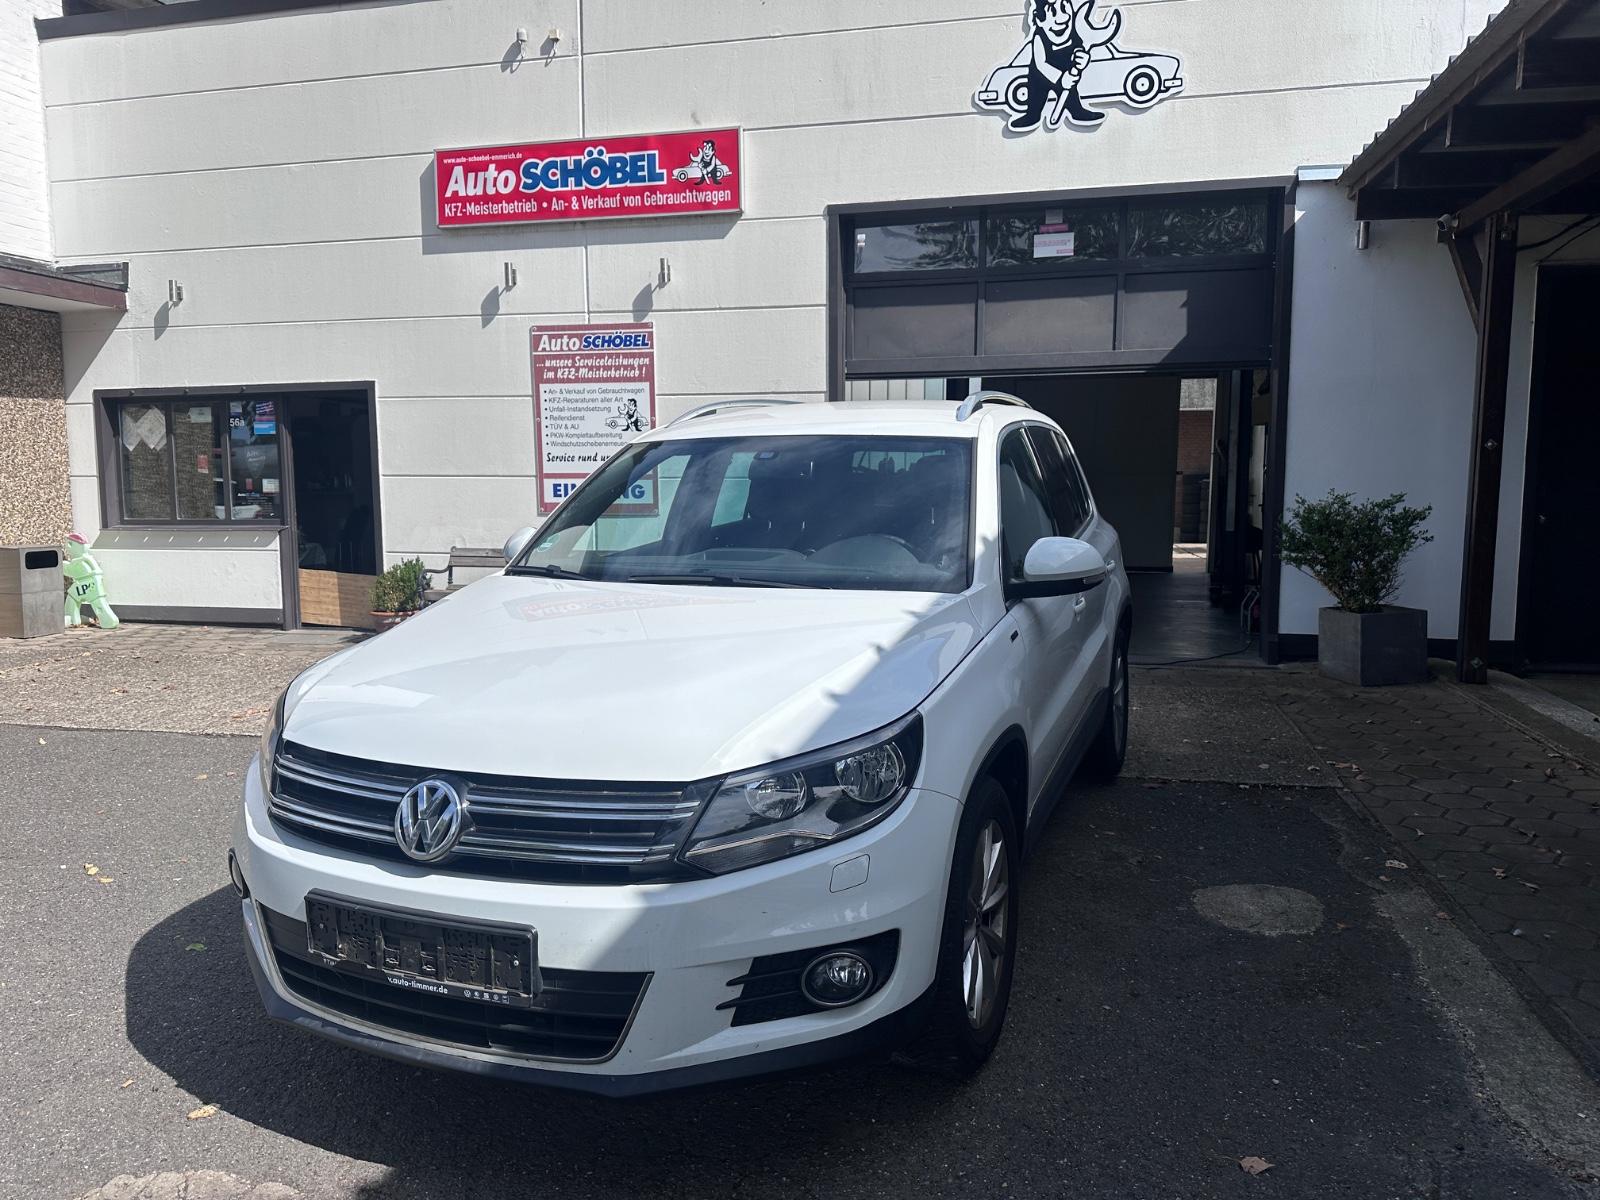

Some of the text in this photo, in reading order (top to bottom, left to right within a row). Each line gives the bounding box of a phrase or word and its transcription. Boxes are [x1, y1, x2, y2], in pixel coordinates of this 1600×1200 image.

[443, 152, 523, 164] www.auto-schoebel-emmerich.de
[444, 147, 666, 198] Auto SCHÖBEL
[444, 189, 731, 217] KFZ-Meisterbetrieb An- & Verkauf von Gebrauchtwagen
[538, 331, 650, 351] Auto SCHÖBEL
[575, 355, 649, 368] Serviceleistungen
[543, 369, 555, 379] im
[557, 367, 640, 379] KFZ-Meisterbetrieb
[598, 387, 645, 395] Gebrauchtwagen
[230, 418, 245, 427] 56a
[550, 422, 563, 430] TÜV
[546, 452, 576, 463] Service
[578, 451, 598, 462] rund
